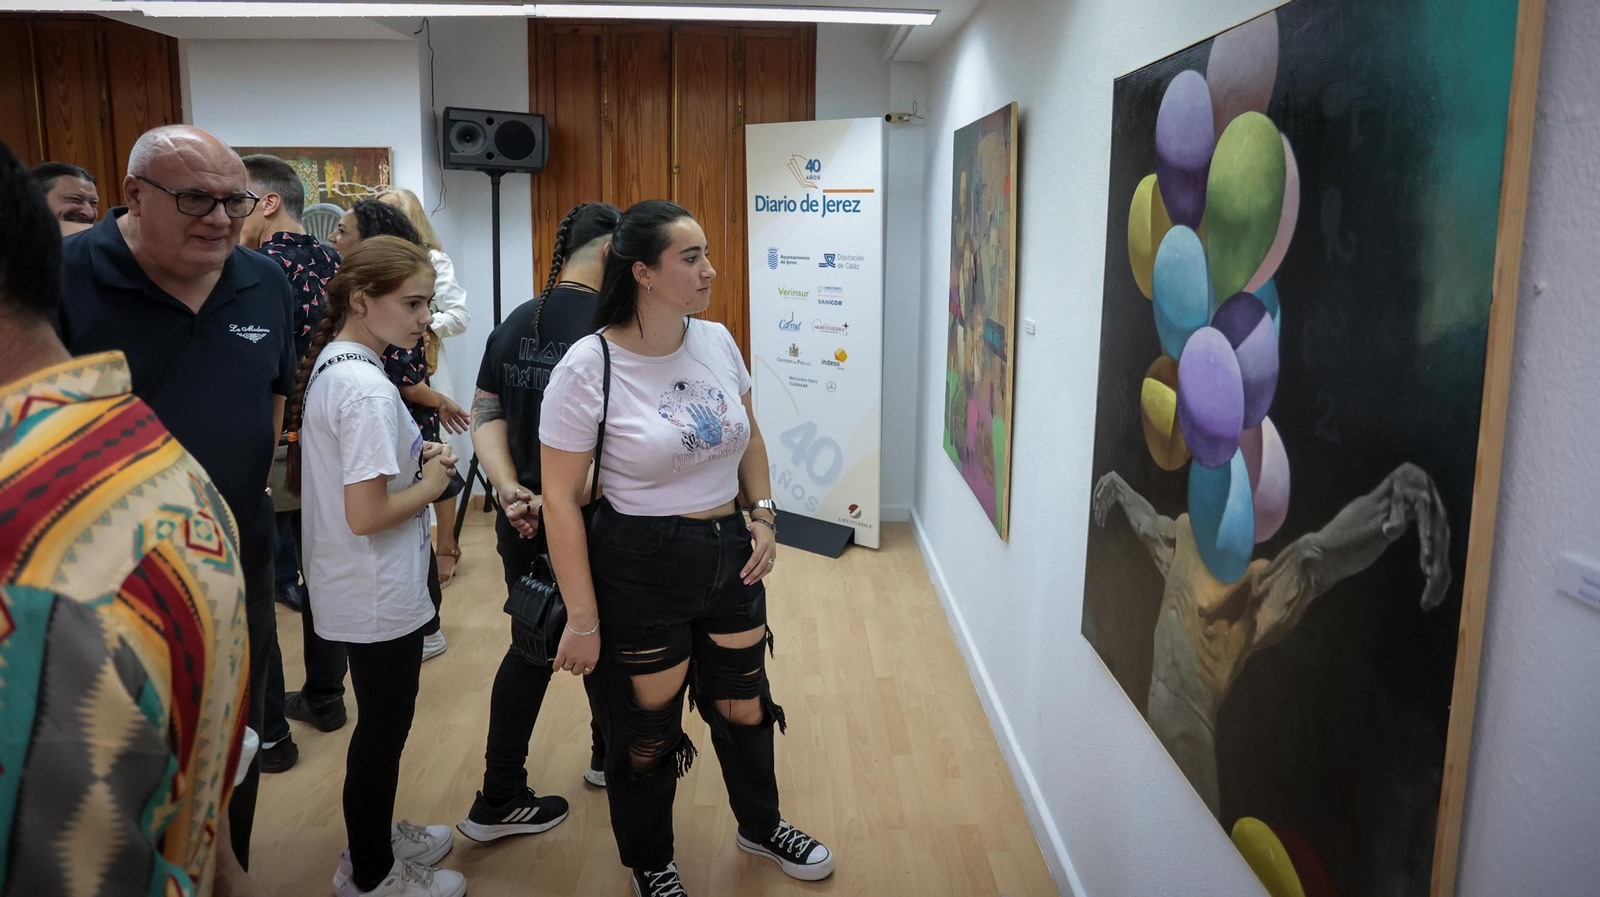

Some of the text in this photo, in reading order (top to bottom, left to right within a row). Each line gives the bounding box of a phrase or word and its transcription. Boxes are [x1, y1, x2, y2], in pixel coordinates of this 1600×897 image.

[805, 159, 821, 172] 40
[755, 193, 861, 218] Diario de Jerez
[780, 254, 810, 262] Ayuntamiento
[837, 253, 864, 262] Diputación
[846, 262, 860, 270] Cádiz
[778, 286, 809, 297] Verinsur
[779, 420, 844, 487] 40
